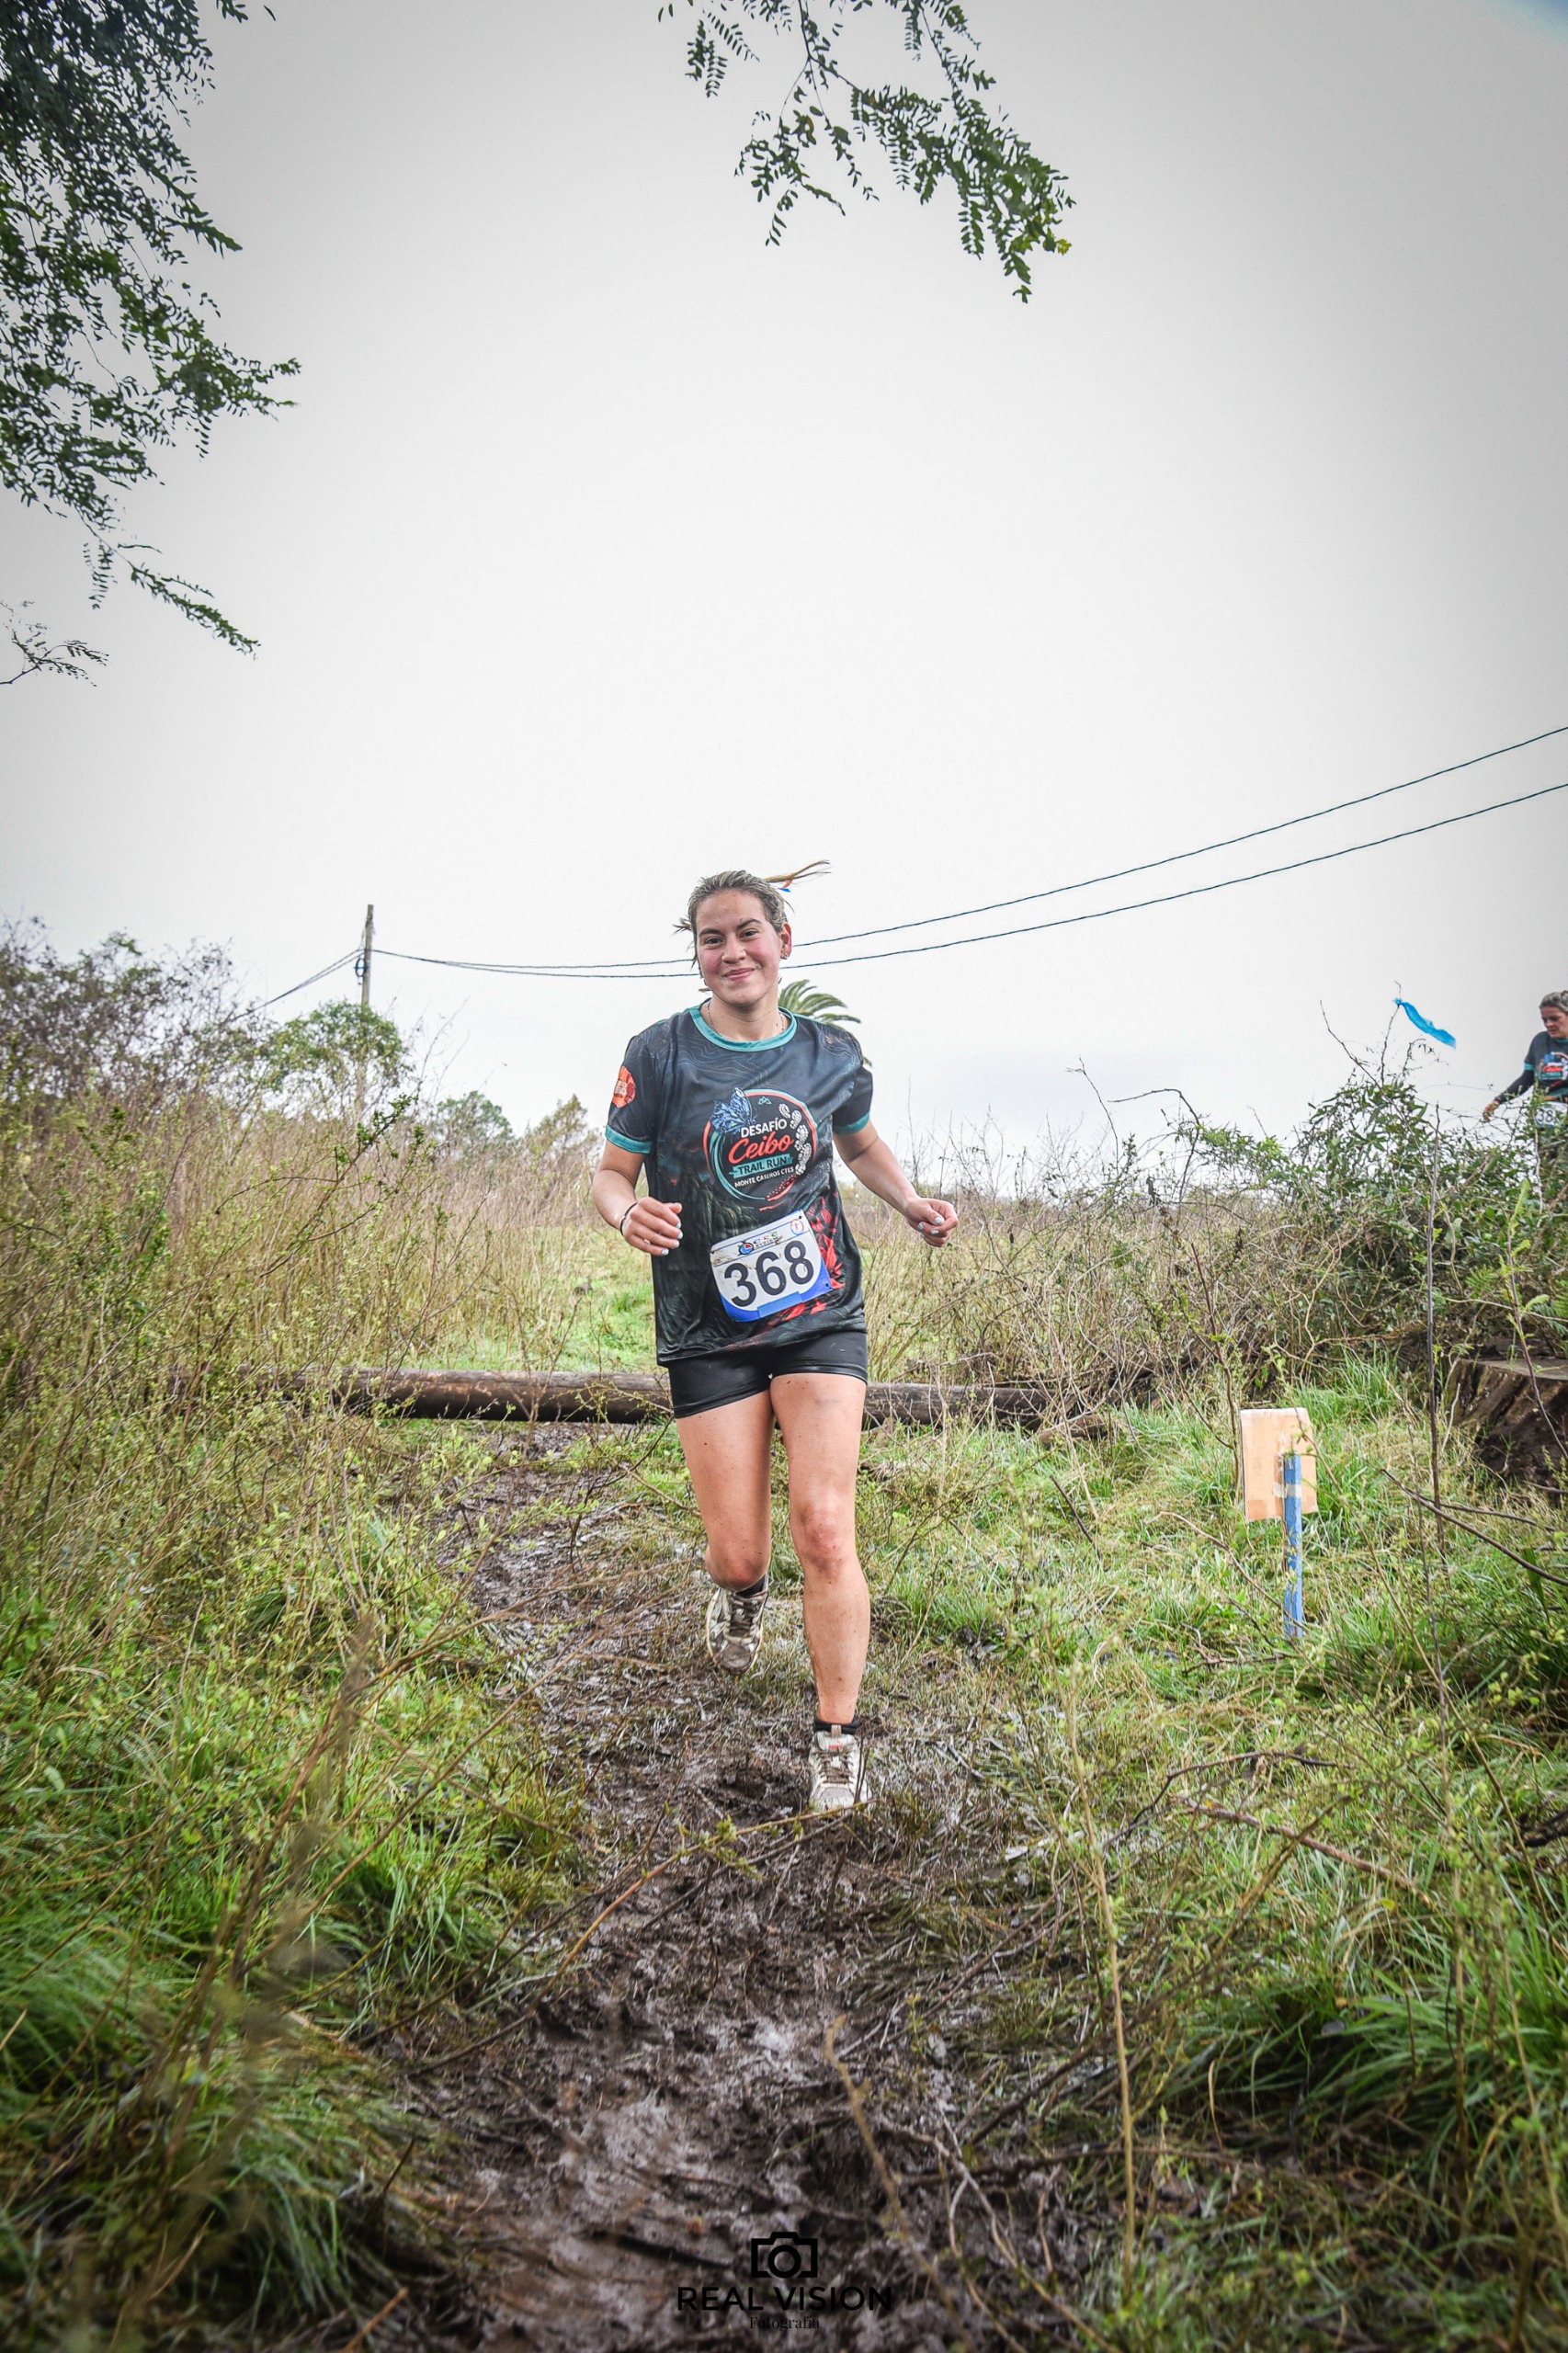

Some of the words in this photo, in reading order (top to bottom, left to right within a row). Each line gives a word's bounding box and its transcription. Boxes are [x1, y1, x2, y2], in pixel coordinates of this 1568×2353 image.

[741, 1118, 788, 1138] DESAFÍO
[728, 1131, 794, 1165] Ceibo
[738, 1161, 766, 1175] TRAIL
[767, 1156, 788, 1168] RUN
[734, 1176, 756, 1188] MONTE
[724, 1240, 814, 1307] 368
